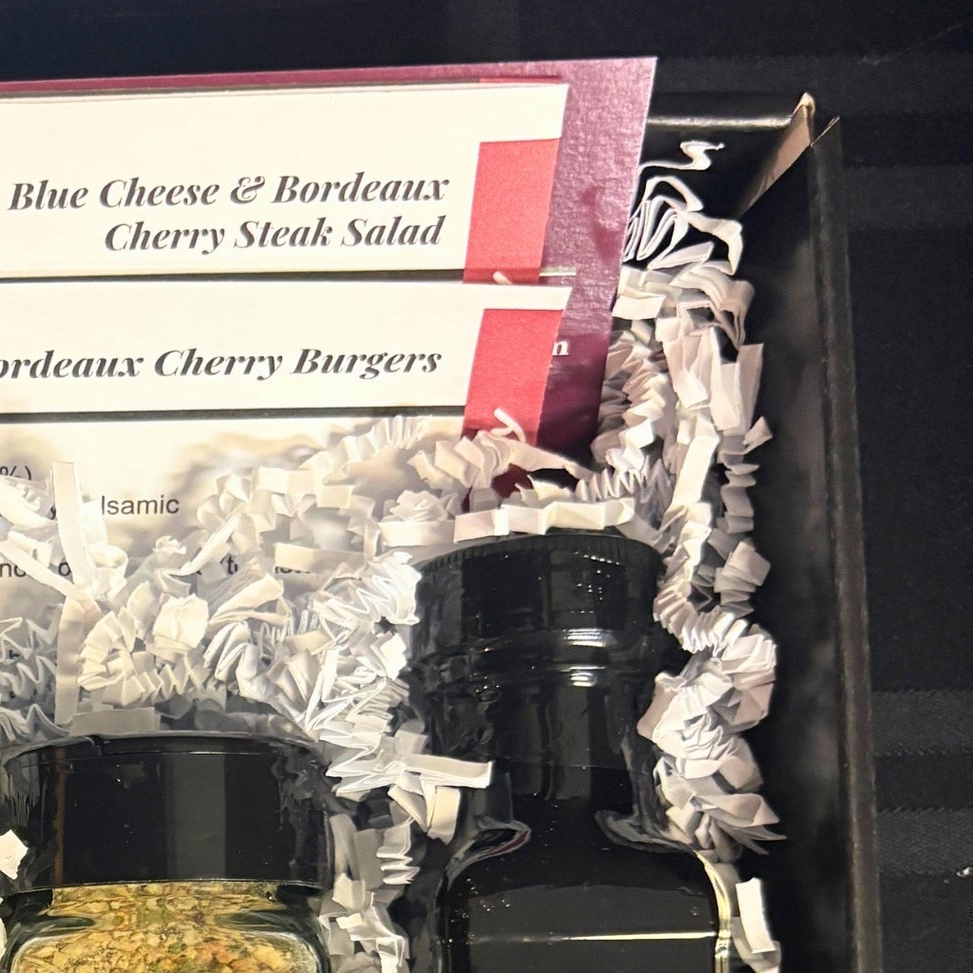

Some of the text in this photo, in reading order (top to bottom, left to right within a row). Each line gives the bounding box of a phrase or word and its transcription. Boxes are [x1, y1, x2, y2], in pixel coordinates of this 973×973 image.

[9, 171, 450, 210] Blue Cheese & Bordeaux
[105, 215, 446, 255] Cherry Steak Salad
[154, 348, 283, 381] Cherry
[293, 348, 442, 379] Burgers
[100, 494, 180, 516] lsamic
